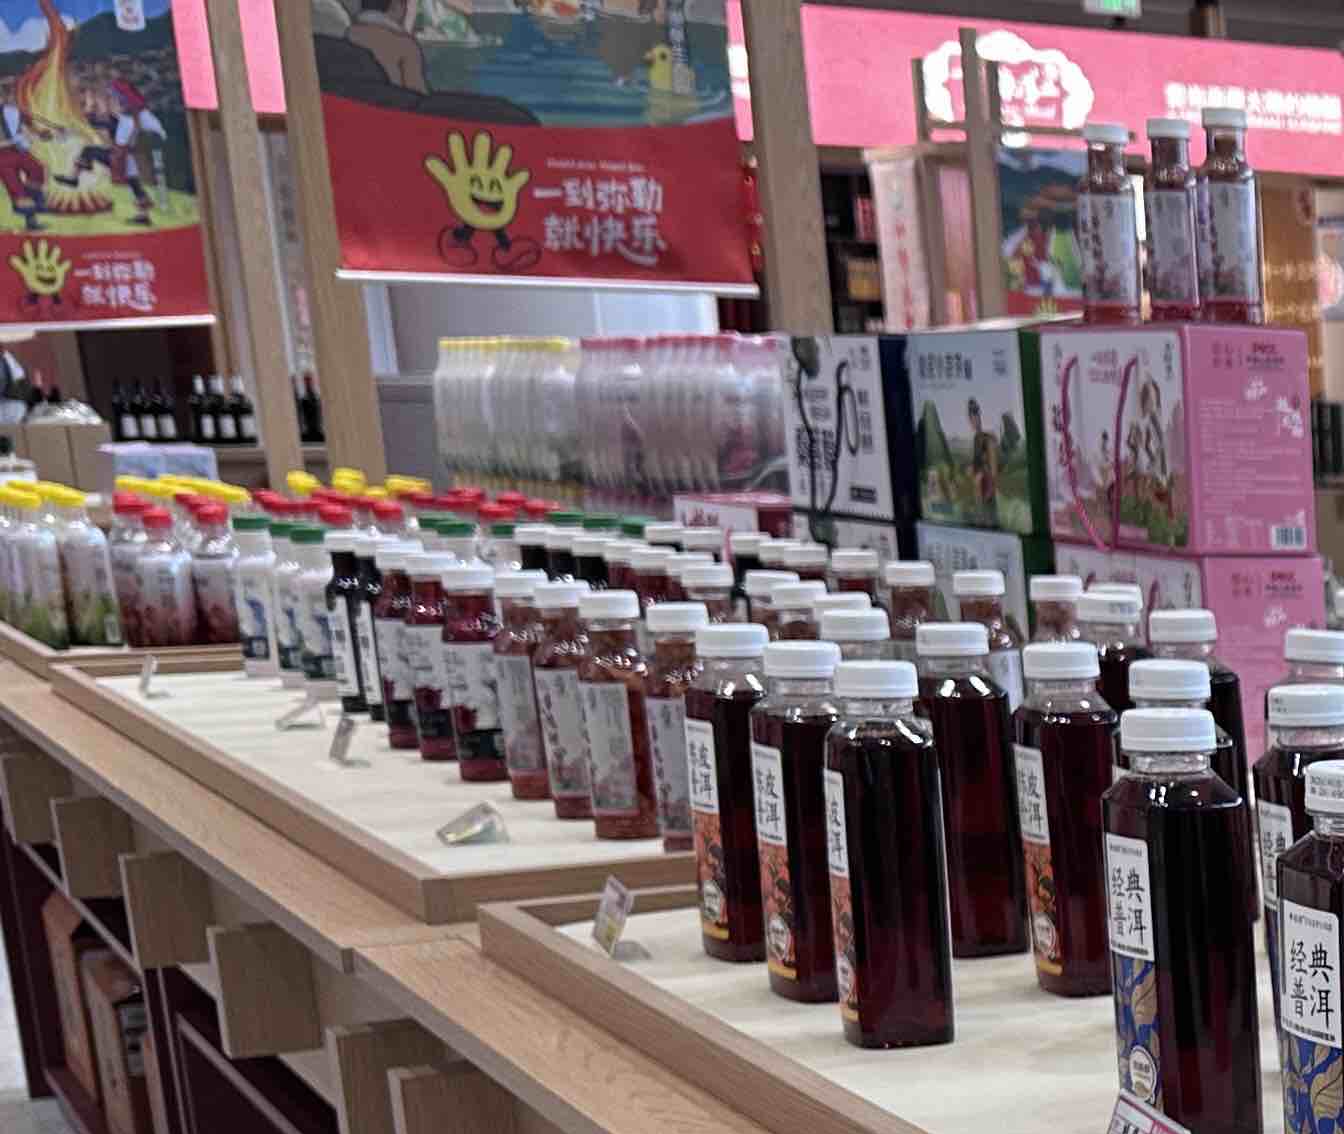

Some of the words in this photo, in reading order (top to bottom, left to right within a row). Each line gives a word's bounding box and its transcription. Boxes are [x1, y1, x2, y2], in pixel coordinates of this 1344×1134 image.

[533, 173, 664, 212] 一到弥勒
[543, 214, 668, 266] 就快乐
[1290, 939, 1335, 984] 经典
[1290, 978, 1335, 1030] 普洱
